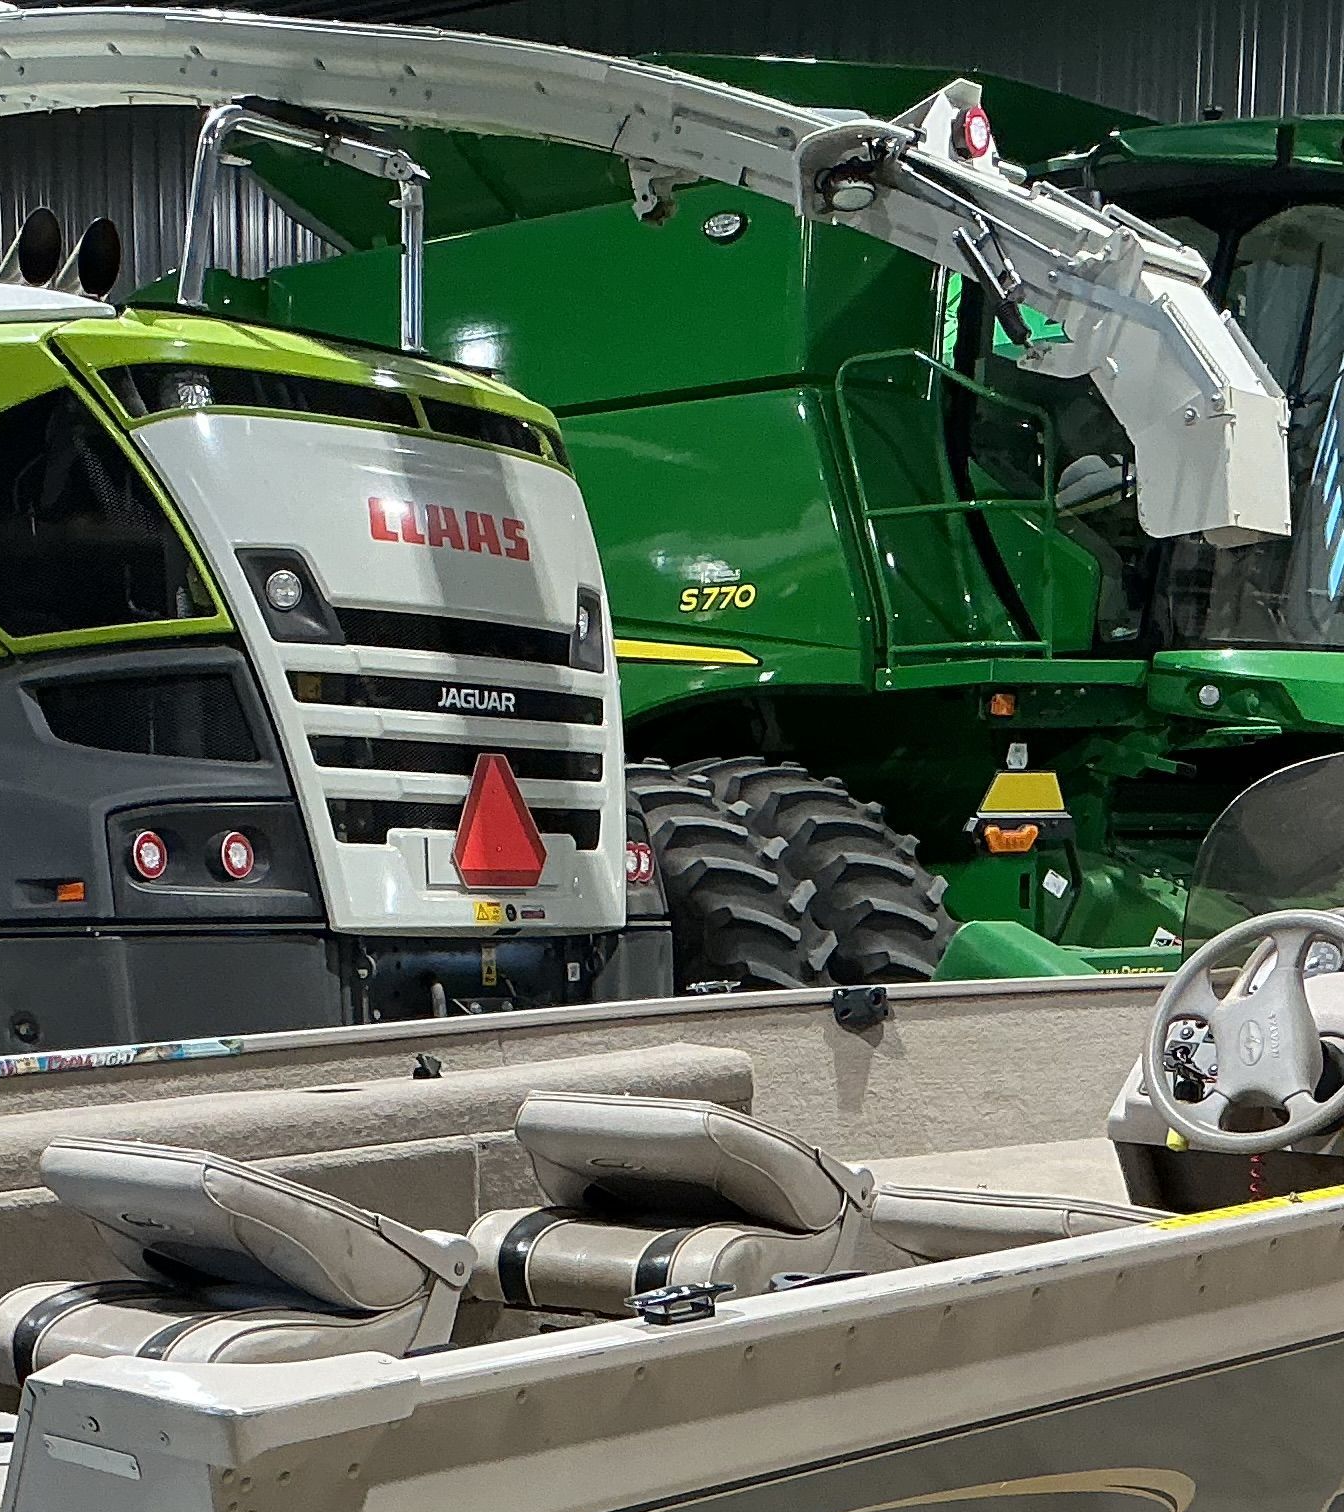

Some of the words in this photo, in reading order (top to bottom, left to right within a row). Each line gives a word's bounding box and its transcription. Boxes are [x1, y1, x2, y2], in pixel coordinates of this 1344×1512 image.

[368, 496, 530, 562] CLAAS
[678, 583, 757, 613] S770
[437, 686, 516, 713] JAGUAR
